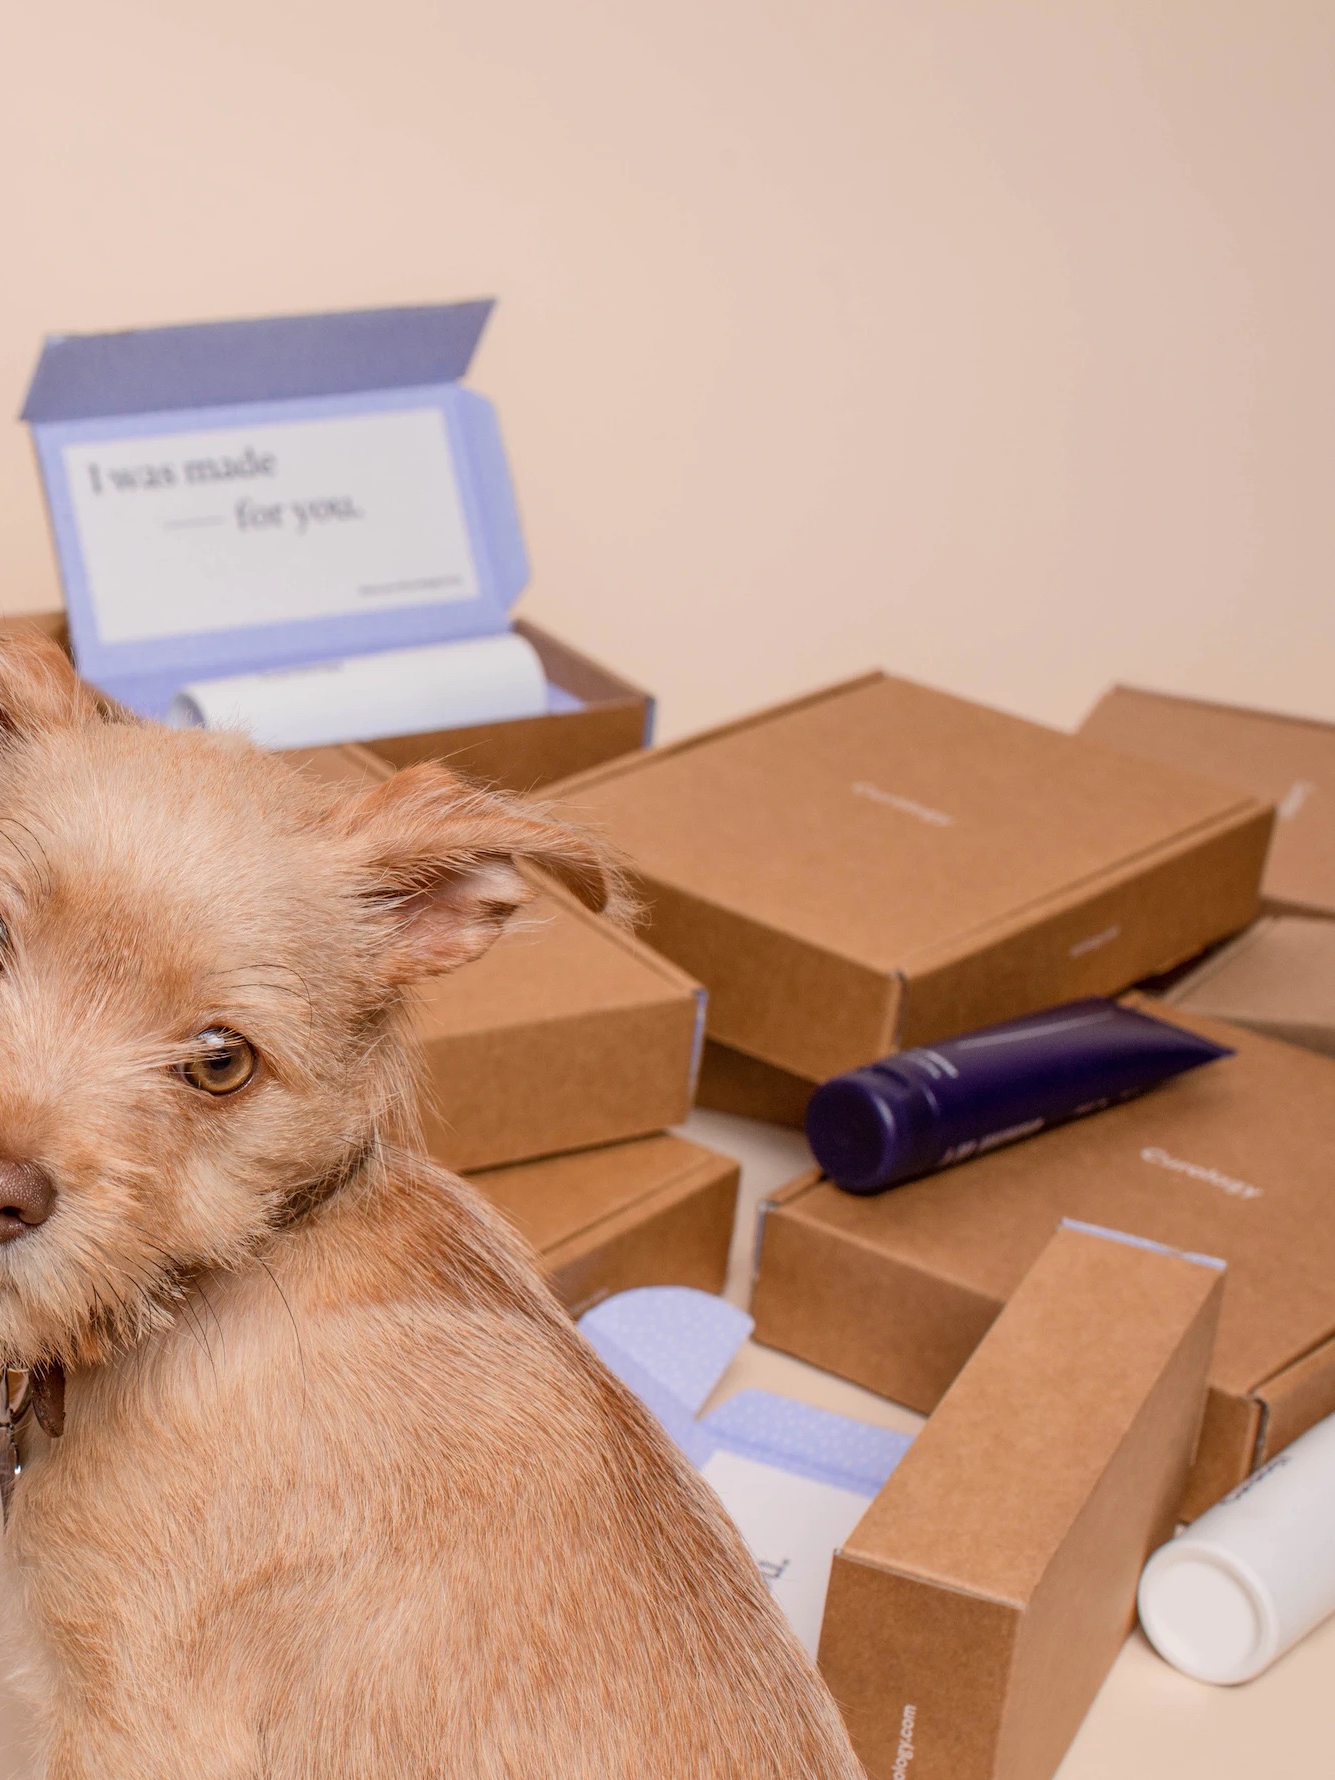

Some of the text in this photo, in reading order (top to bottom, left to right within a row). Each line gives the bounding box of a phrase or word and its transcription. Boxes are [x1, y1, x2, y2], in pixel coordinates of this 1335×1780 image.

[88, 446, 277, 495] I was made
[234, 496, 366, 536] for you.
